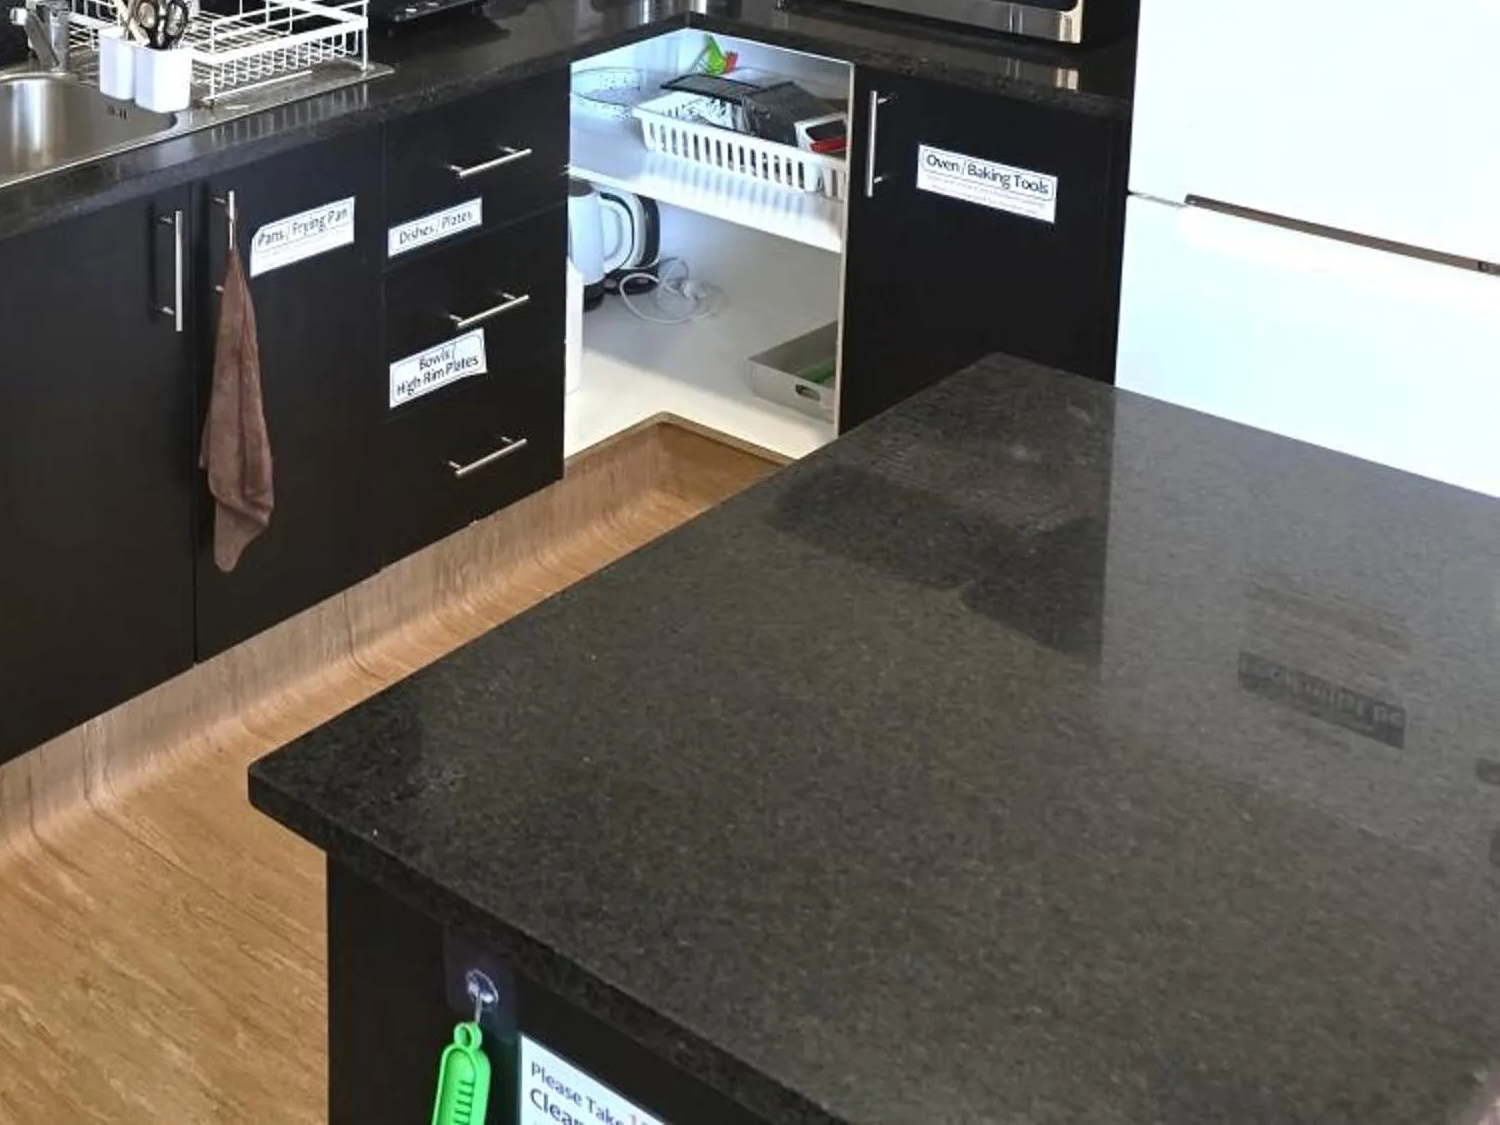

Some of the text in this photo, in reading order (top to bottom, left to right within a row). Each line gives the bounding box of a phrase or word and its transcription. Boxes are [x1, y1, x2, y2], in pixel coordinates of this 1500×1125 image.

[925, 153, 961, 174] Oven
[967, 163, 1011, 190] Baking
[1013, 174, 1049, 196] Tools
[291, 216, 327, 238] Frying
[327, 206, 348, 225] Pan
[441, 210, 473, 230] Plates
[396, 354, 480, 398] High Rim Plates
[531, 1060, 583, 1107] Please
